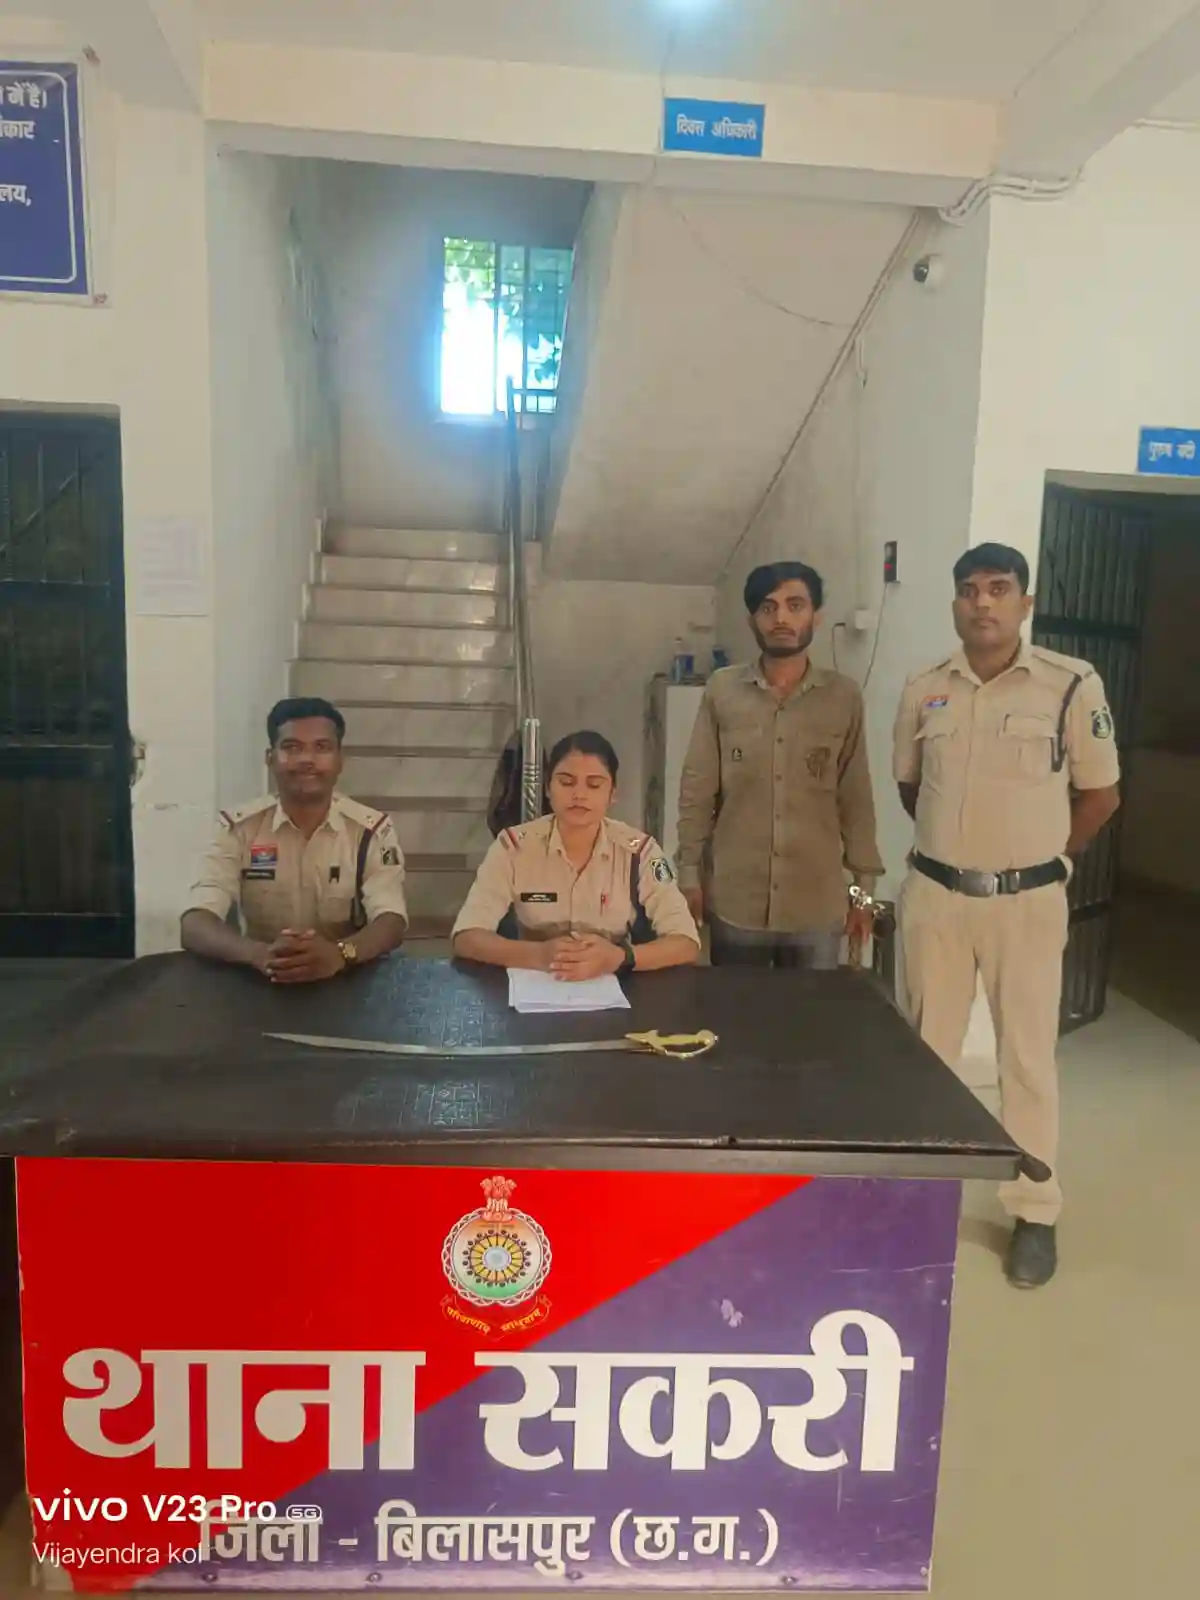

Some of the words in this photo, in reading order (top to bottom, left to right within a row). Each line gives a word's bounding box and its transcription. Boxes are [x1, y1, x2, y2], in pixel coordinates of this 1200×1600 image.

[0, 115, 36, 139] कार
[0, 184, 32, 207] लय,
[62, 1348, 426, 1470] थाना
[474, 1310, 915, 1472] सकरी
[199, 1499, 324, 1563] जिला
[374, 1500, 596, 1577] बिलासपुर
[609, 1508, 779, 1568] (छ.ग.)
